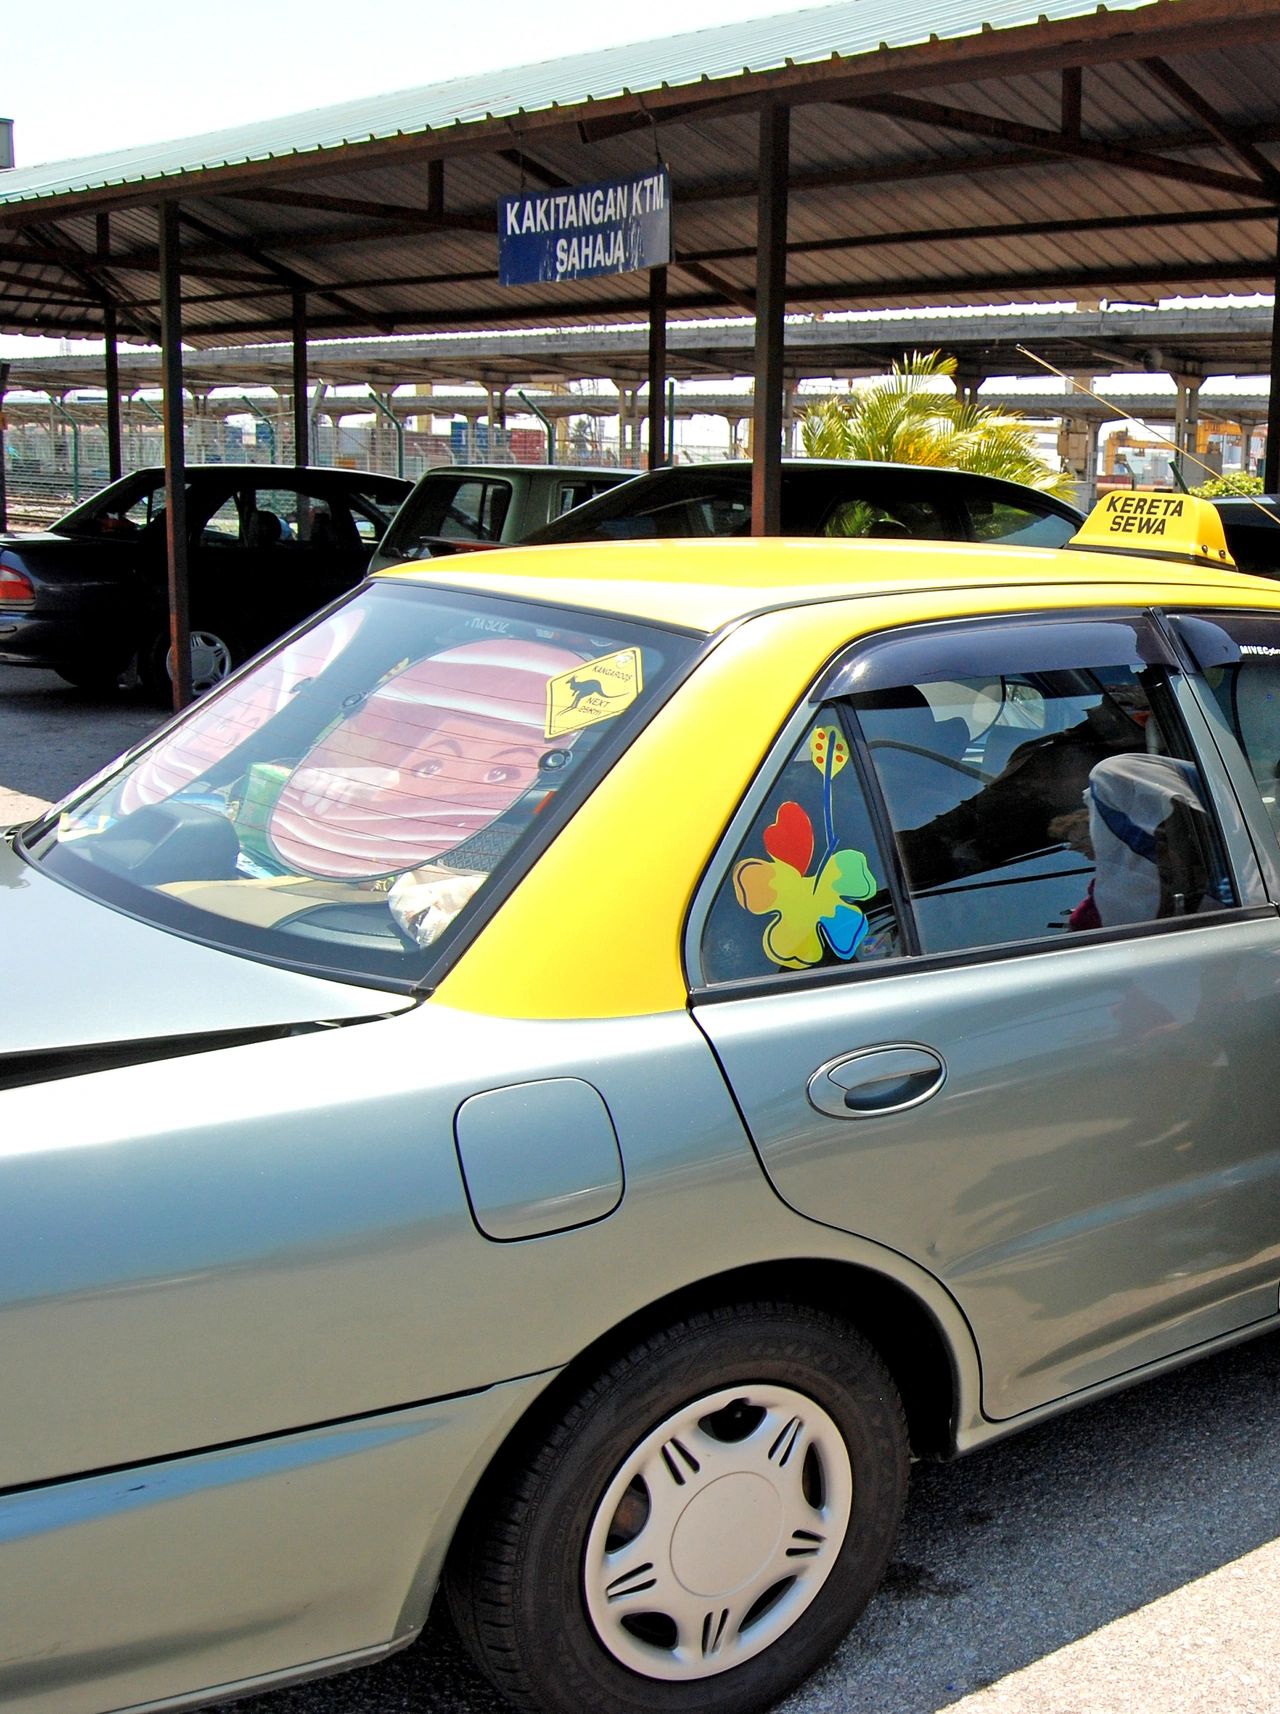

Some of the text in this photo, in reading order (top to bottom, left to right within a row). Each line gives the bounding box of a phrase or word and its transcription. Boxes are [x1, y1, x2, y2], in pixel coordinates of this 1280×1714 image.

[507, 173, 664, 236] KAKITANGAN KTM
[555, 230, 625, 273] SAHAJA
[1106, 496, 1184, 517] KERETA
[1109, 515, 1167, 536] SEWA
[587, 697, 610, 708] NEXT
